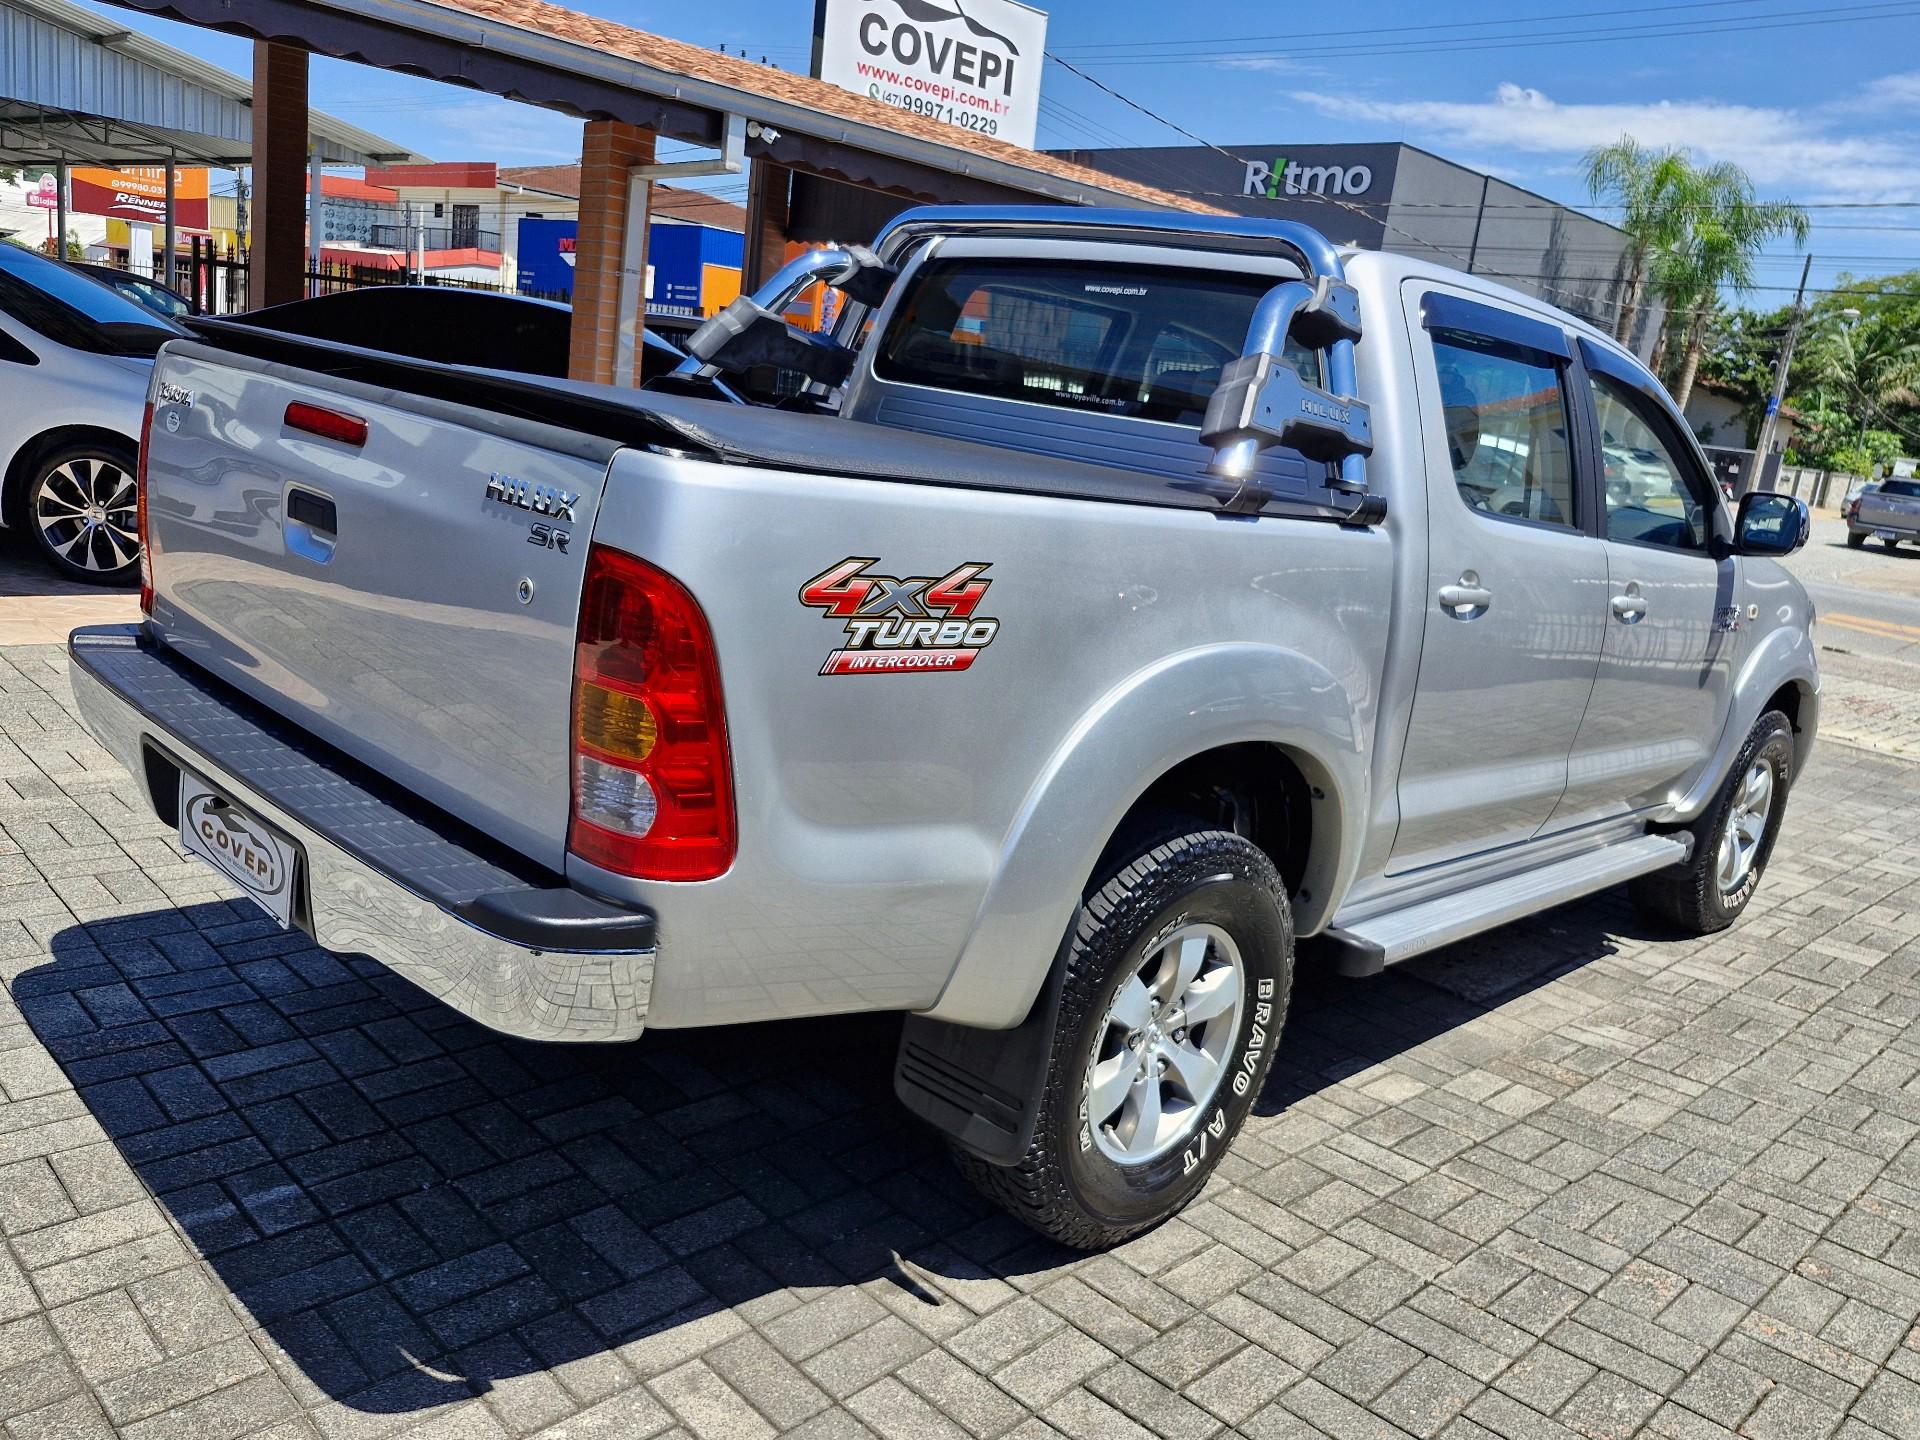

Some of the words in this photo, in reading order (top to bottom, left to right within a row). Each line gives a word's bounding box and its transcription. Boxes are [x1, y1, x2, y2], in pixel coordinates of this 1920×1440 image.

[859, 12, 1015, 97] COVEPI
[856, 61, 1010, 117] www.covepi.com.br
[1084, 284, 1149, 297] www.covepi.com.br
[1301, 399, 1351, 425] HILUX
[486, 472, 581, 524] HILUX
[527, 522, 571, 555] SR
[844, 616, 1000, 650] TURBO
[848, 654, 957, 670] INTERCOOLER
[201, 820, 276, 887] COVEPI
[1233, 978, 1275, 1097] BRAVO
[1183, 1108, 1227, 1176] A/T
